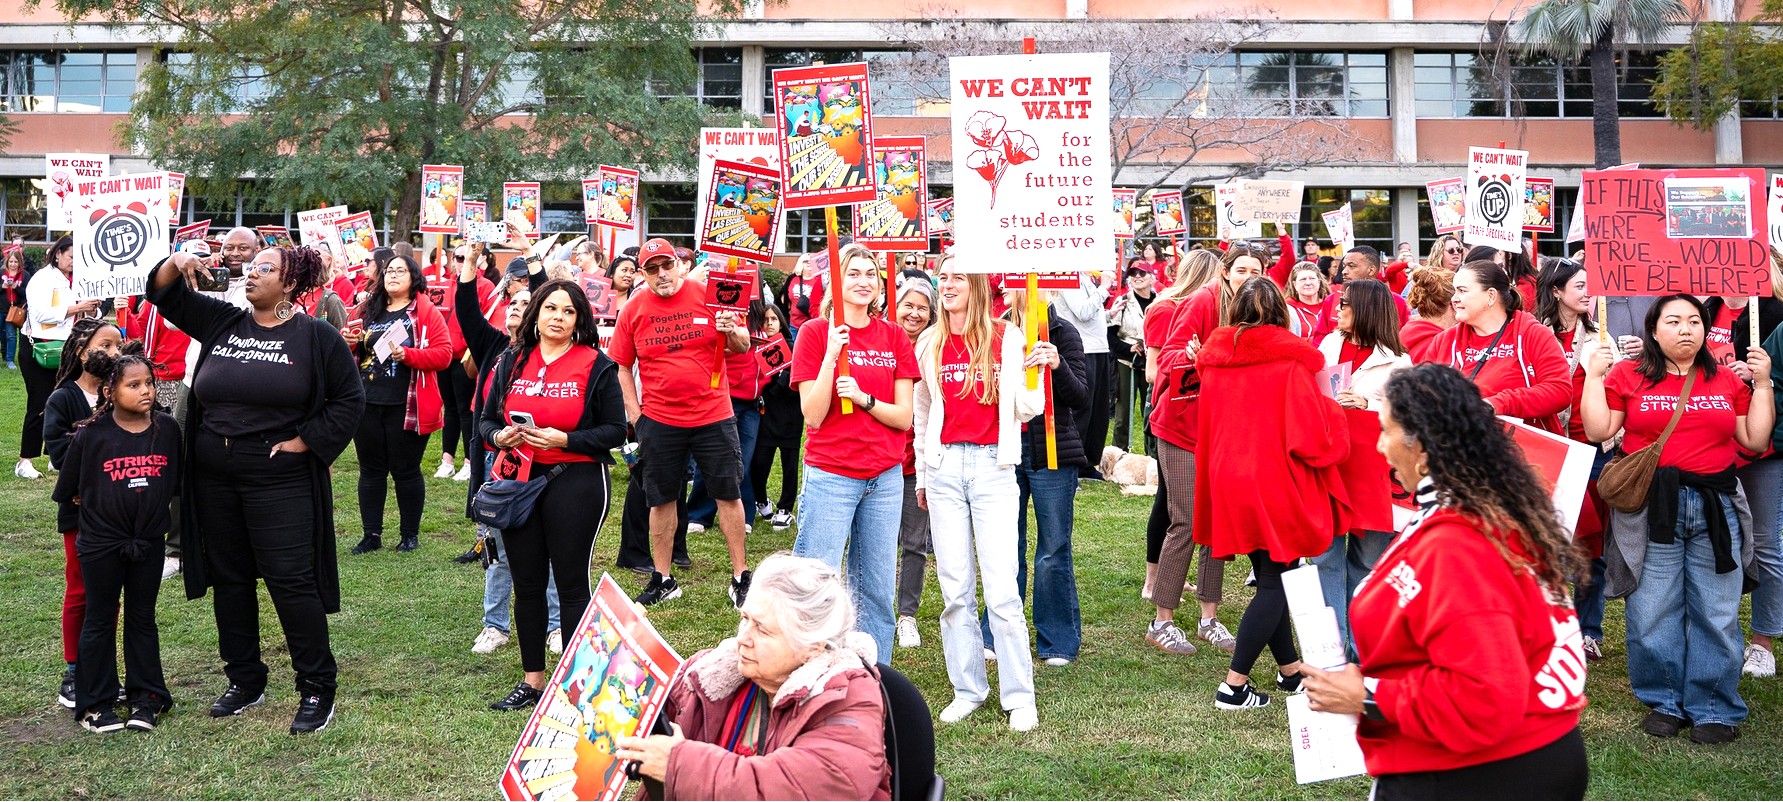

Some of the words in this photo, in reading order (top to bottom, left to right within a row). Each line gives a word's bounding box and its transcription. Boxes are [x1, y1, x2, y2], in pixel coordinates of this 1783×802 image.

[959, 79, 1004, 98] WE
[1010, 77, 1092, 97] CAN'T
[1021, 100, 1092, 120] WAIT
[705, 132, 721, 146] WE
[724, 132, 754, 146] CAN'T
[757, 132, 778, 146] WAI
[1062, 131, 1092, 147] for
[51, 159, 69, 167] WE
[71, 160, 103, 168] CAN'T
[1059, 152, 1093, 167] the
[1473, 152, 1484, 163] WE
[1485, 153, 1504, 165] CAN'T
[1506, 154, 1523, 167] WAIT
[75, 169, 103, 177] WAIT
[1025, 172, 1093, 187] future
[79, 182, 96, 196] WE
[100, 178, 131, 194] CAN'T
[134, 176, 163, 190] WAIT
[1257, 189, 1291, 197] ANYWHERE
[1585, 177, 1608, 204] IF
[1614, 178, 1665, 211] THIS
[1057, 195, 1094, 207] our
[1486, 199, 1505, 216] UP
[317, 211, 342, 220] CAN'T
[1000, 212, 1095, 228] students
[1254, 211, 1299, 221] EVERYWHERE
[105, 224, 132, 238] TIME'S
[1469, 225, 1485, 237] STAFF
[1585, 215, 1637, 239] WERE
[105, 232, 138, 257] UP
[1006, 235, 1095, 250] deserve
[1680, 239, 1766, 268] WOULD
[78, 278, 104, 298] STAFF
[1599, 265, 1638, 292] WE
[1647, 265, 1682, 293] BE
[1690, 267, 1770, 296] HERE?
[650, 312, 693, 324] Together
[655, 326, 671, 334] We
[674, 323, 692, 331] Are
[227, 334, 285, 350] UNIONIZE
[645, 330, 705, 346] STRONGER!
[103, 455, 168, 472] STRIKES
[110, 466, 161, 482] WORK
